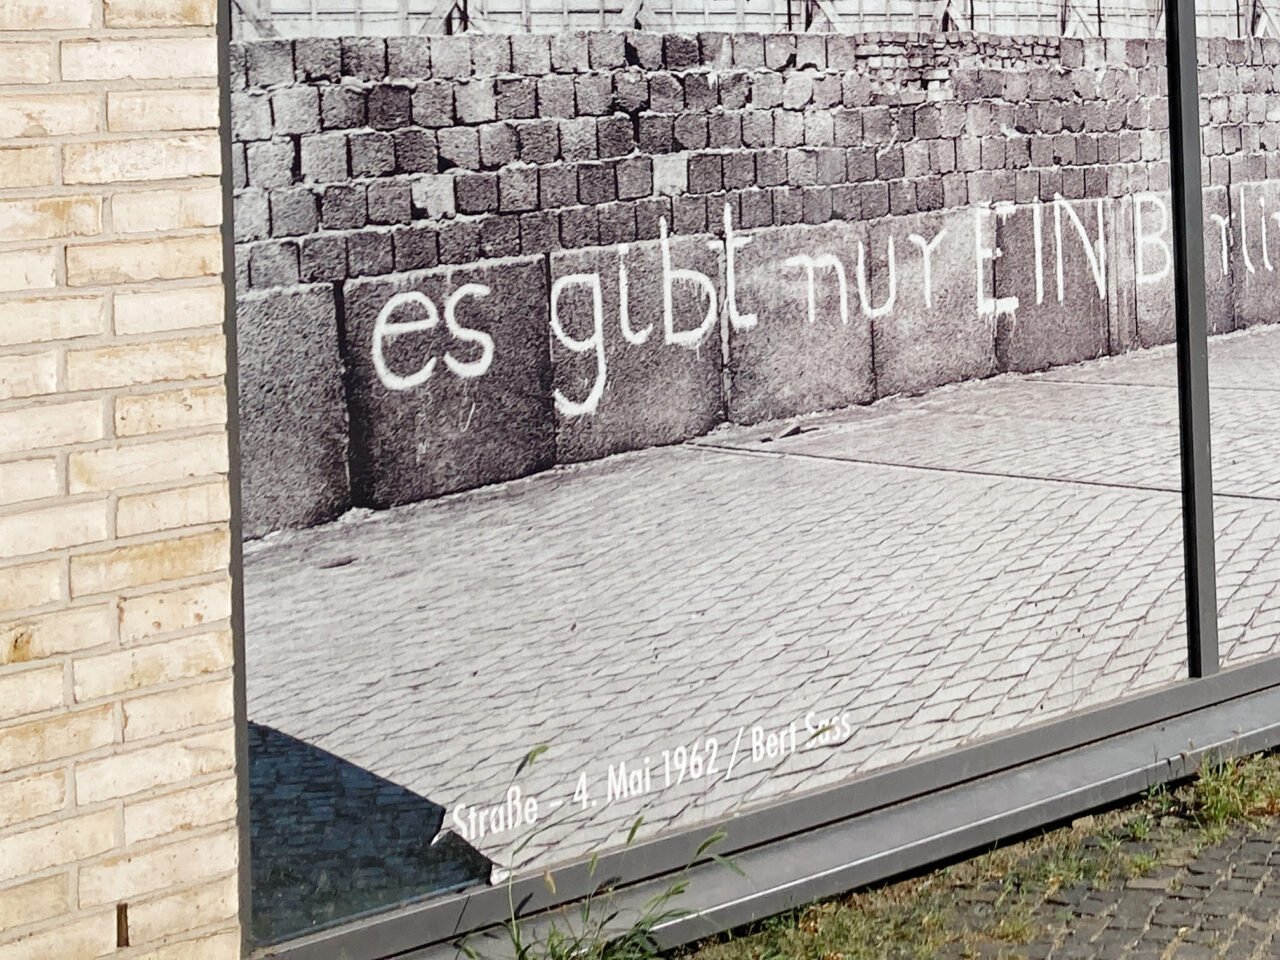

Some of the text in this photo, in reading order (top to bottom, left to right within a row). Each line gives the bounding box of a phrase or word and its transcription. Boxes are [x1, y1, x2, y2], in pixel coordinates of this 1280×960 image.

[372, 283, 494, 390] es
[550, 203, 758, 416] gibt
[975, 192, 1109, 314] EIN
[452, 785, 538, 840] Straße
[573, 771, 597, 810] 4.
[607, 759, 651, 802] Mai
[662, 737, 719, 787] 1962
[726, 725, 745, 780] /
[752, 721, 796, 763] Bert
[805, 711, 852, 748] Sass
